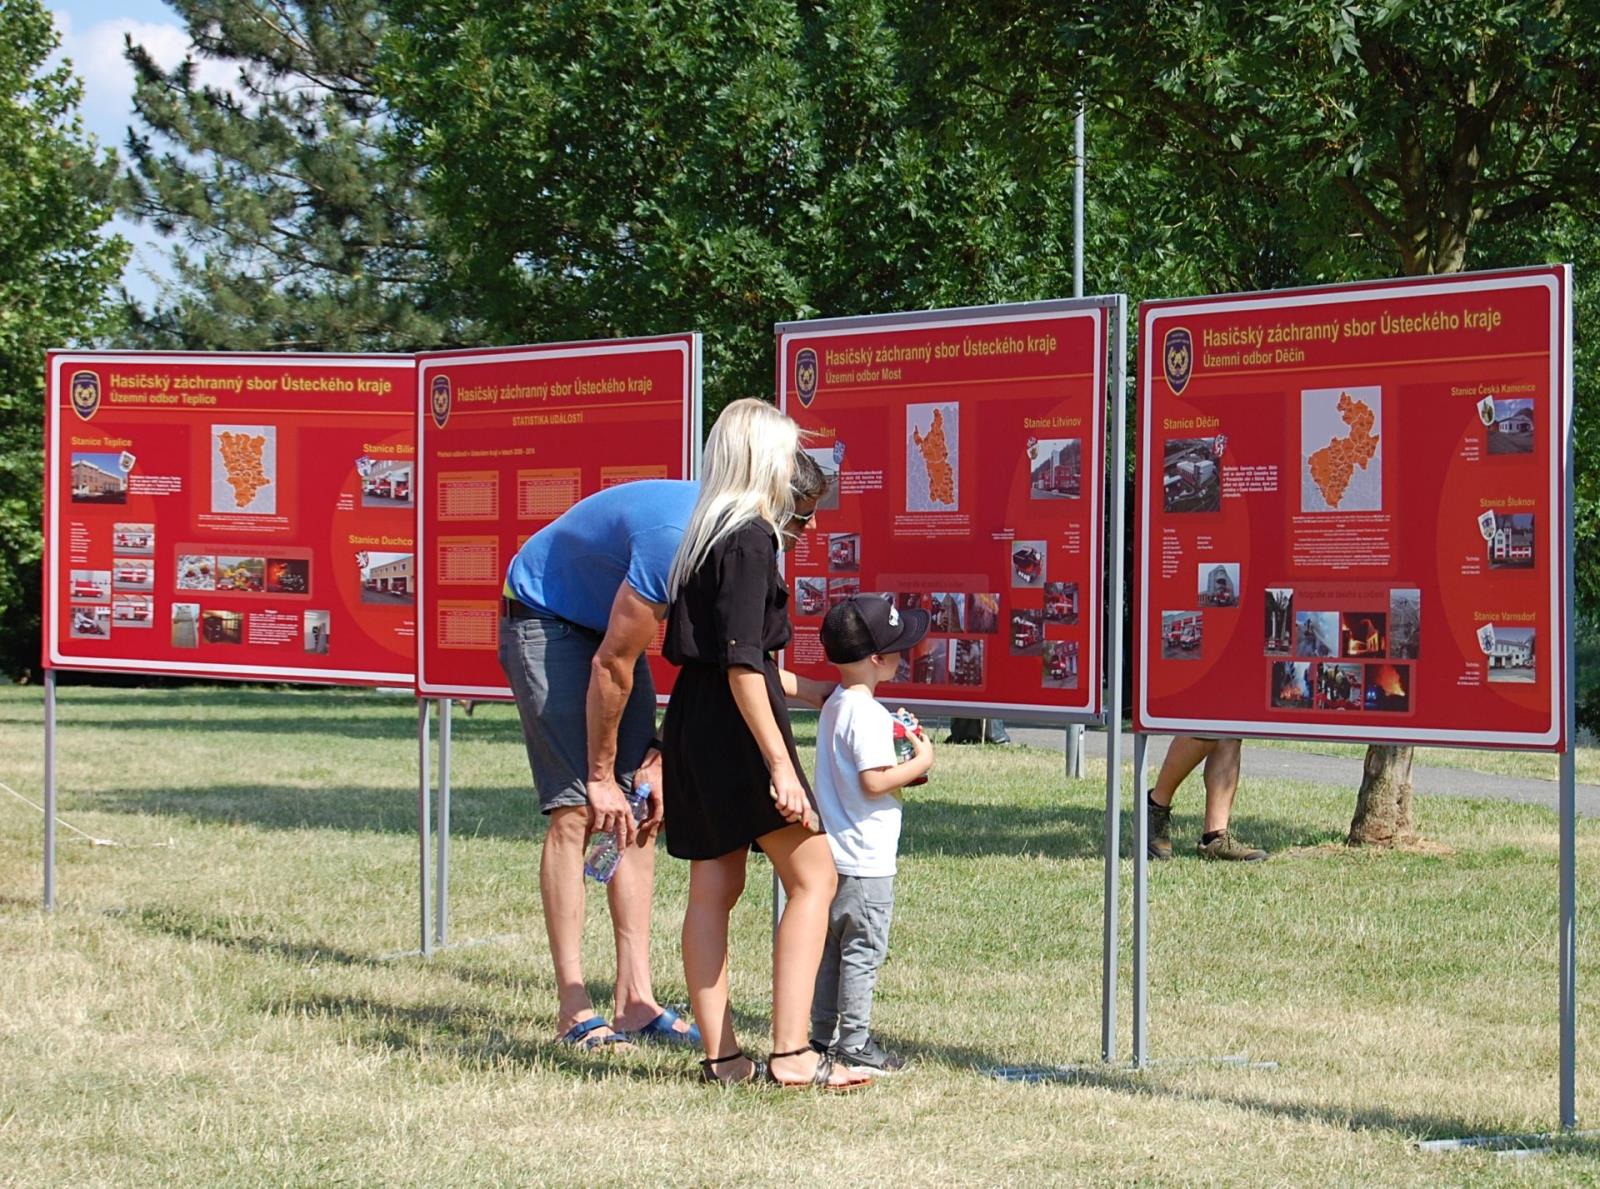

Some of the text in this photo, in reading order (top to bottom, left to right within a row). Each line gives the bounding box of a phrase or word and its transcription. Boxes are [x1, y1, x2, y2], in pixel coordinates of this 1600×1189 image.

[1203, 325, 1263, 348] Hasičský
[1267, 319, 1341, 343] záchranný
[1343, 317, 1377, 337] sbor
[1380, 309, 1460, 335] Ústeckého
[1463, 306, 1502, 332] kraje
[824, 347, 873, 367] Hasičský
[875, 341, 932, 364] záchranný
[934, 340, 961, 359] sbor
[963, 335, 1025, 357] Ústeckého
[1027, 333, 1057, 355] kraje
[1242, 350, 1273, 366] odbor
[1275, 346, 1306, 364] Děčín
[855, 367, 881, 382] odbor
[881, 367, 903, 381] Most
[109, 372, 392, 396] Hasičský záchranný sbor Ústeckého kraje
[457, 375, 654, 404] Hasičský záchranný sbor Ústeckého kraje
[1451, 385, 1477, 397] Stanice
[150, 391, 179, 404] odbor
[181, 392, 218, 407] Teplice
[512, 414, 550, 428] STATISTIKA
[1023, 417, 1051, 430] Stanice
[1162, 416, 1195, 431] Stanice
[71, 435, 133, 449] Stanice Teplice
[362, 442, 396, 454] Stanice
[1479, 497, 1506, 509] Stanice
[348, 533, 413, 546] Stanice Duchco
[1473, 610, 1538, 622] Stanice Varnsdorf
